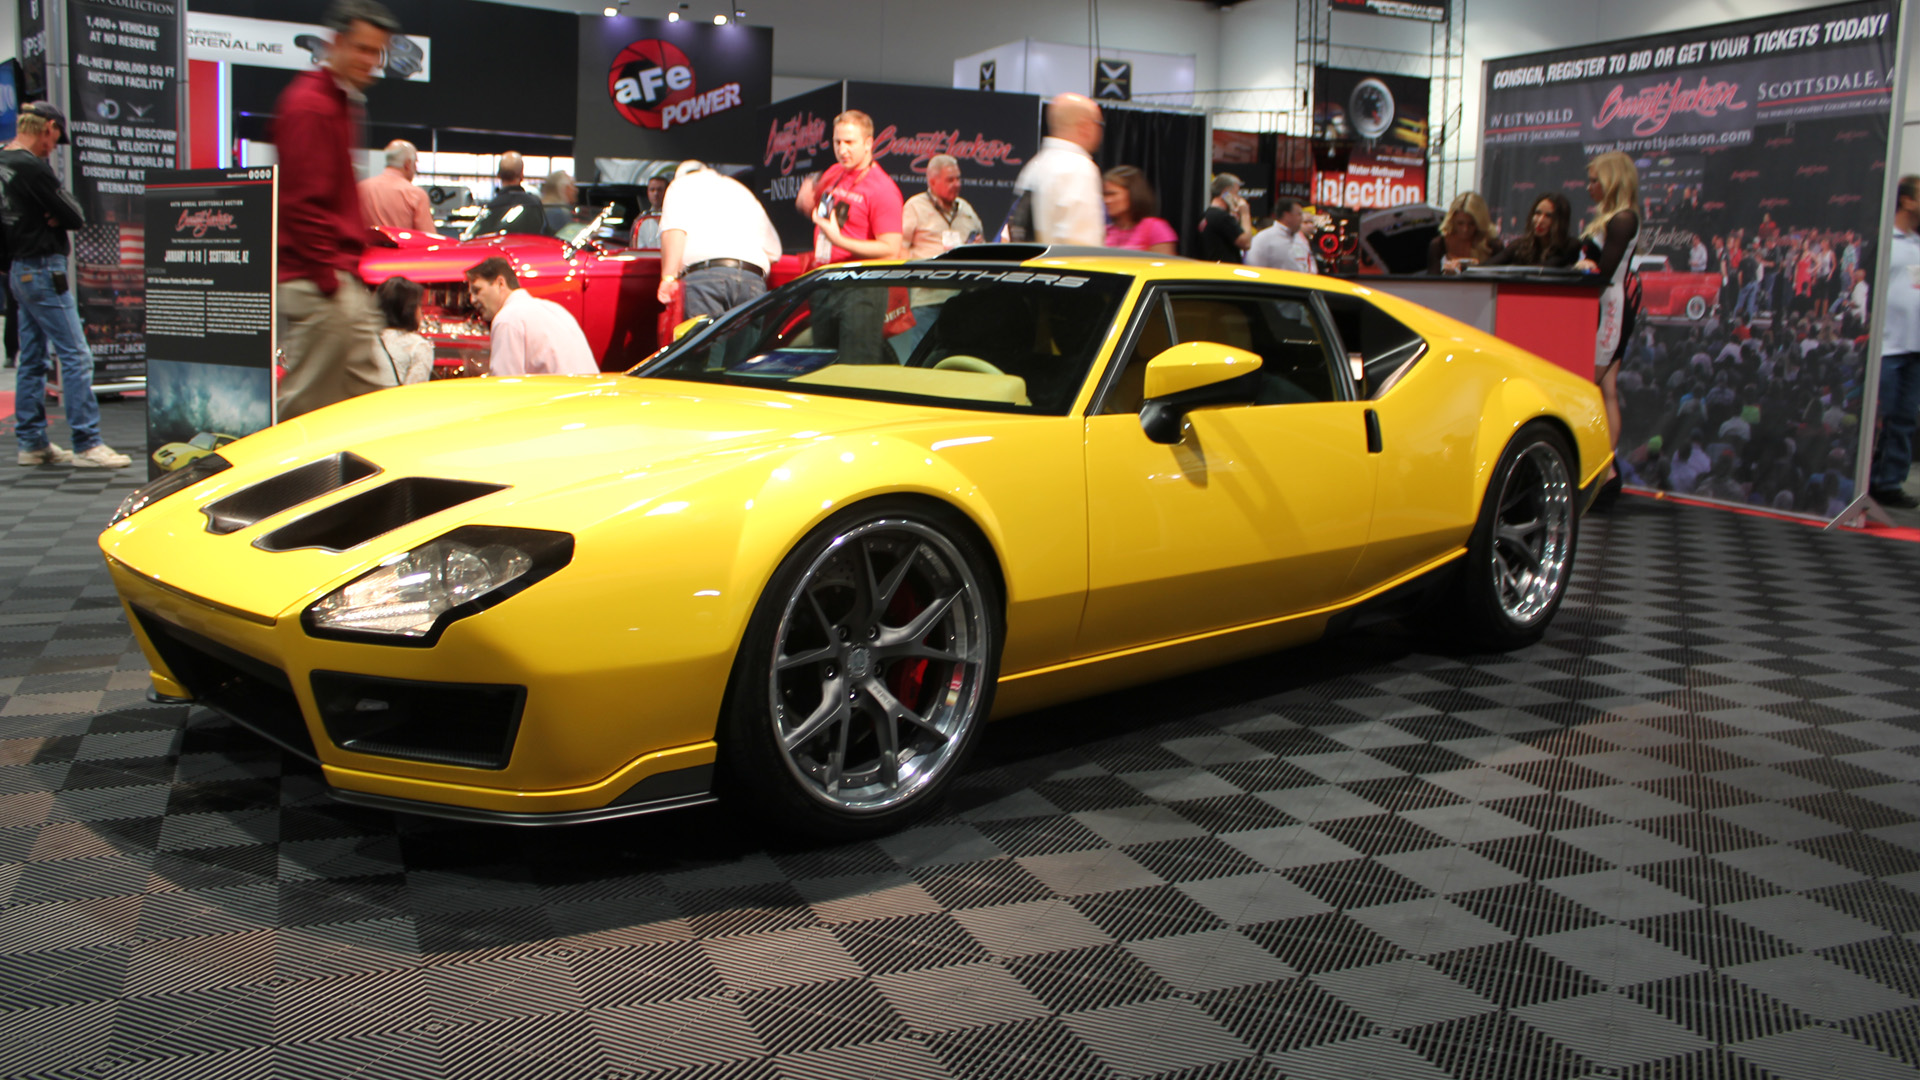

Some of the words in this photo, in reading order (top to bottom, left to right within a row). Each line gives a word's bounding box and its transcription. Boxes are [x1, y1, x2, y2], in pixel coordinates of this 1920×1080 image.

[86, 15, 117, 31] 1,400+
[118, 20, 160, 38] VEHICLES
[89, 30, 102, 42] AT
[103, 33, 117, 46] NO
[118, 34, 157, 51] RESERVE
[1493, 65, 1545, 90] CONSIGN,
[1546, 56, 1605, 83] REGISTER
[1608, 53, 1627, 74] TO
[1627, 49, 1653, 73] BID
[1653, 46, 1676, 68] OR
[1676, 41, 1708, 66] GET
[1709, 35, 1750, 62] YOUR
[1752, 22, 1821, 55] TICKETS
[1822, 12, 1890, 45] TODAY!
[77, 54, 113, 70] ALL-NEW
[113, 59, 148, 75] 900,000
[149, 64, 164, 77] SQ
[165, 66, 175, 78] FT
[87, 71, 124, 86] AUCTION
[125, 75, 165, 91] FACILITY
[614, 65, 692, 104] aFe
[1758, 70, 1879, 101] SCOTTSDALE,
[662, 83, 742, 130] POWER
[1592, 75, 1747, 137] Barrett-Jackson
[100, 124, 120, 136] LIVE
[120, 126, 134, 138] ON
[76, 136, 116, 152] CHANNEL,
[117, 140, 160, 154] VELOCITY
[872, 124, 1023, 174] Barrett-Jackson
[79, 150, 113, 165] AROUND
[113, 153, 130, 166] THE
[131, 155, 164, 168] WORLD
[82, 165, 126, 180] DISCOVERY
[1316, 170, 1421, 208] injection
[164, 249, 186, 263] JANUARY
[817, 268, 1091, 288] RINGBROTHERS
